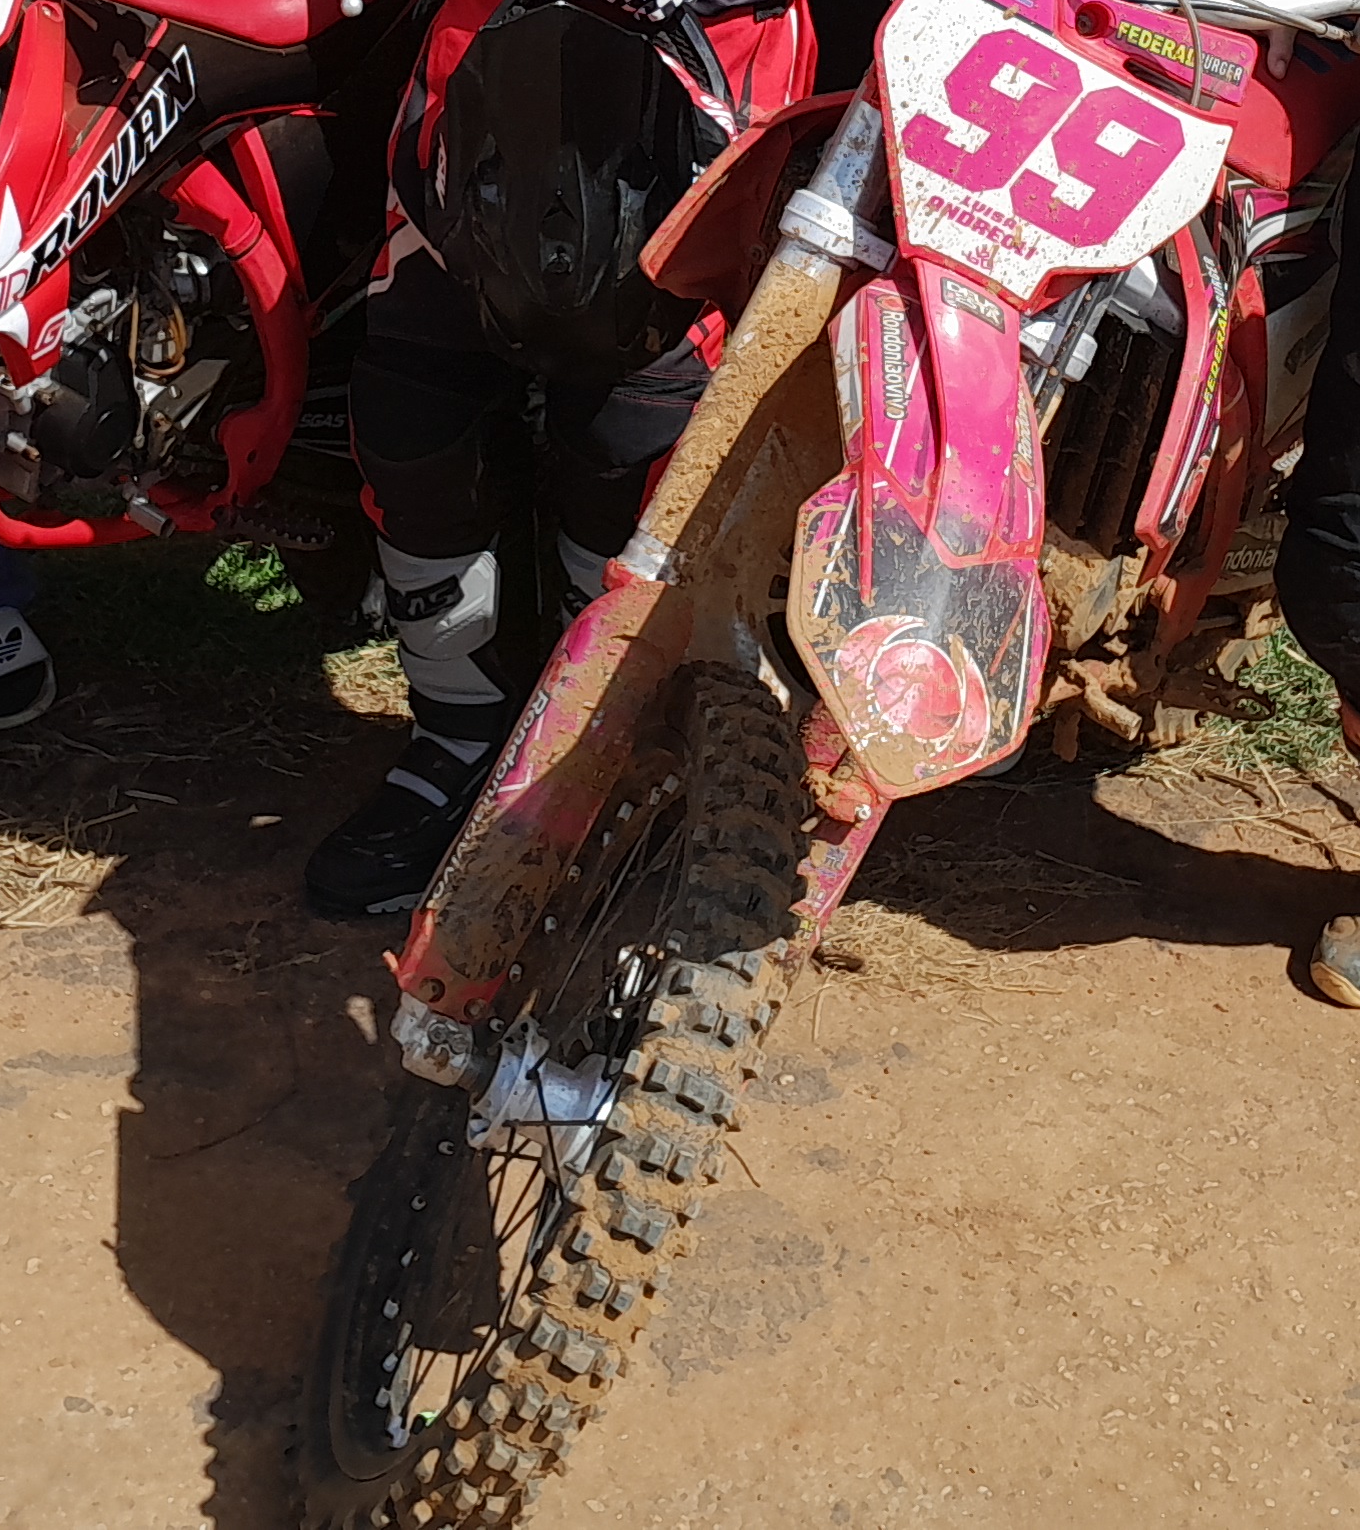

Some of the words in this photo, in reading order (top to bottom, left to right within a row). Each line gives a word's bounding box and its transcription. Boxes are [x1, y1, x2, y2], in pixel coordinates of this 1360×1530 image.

[1116, 20, 1195, 68] FEDERAL
[1202, 52, 1245, 82] URGER
[24, 44, 198, 294] ROVAN
[901, 28, 1186, 248] 99
[959, 195, 1018, 231] LUISA
[882, 310, 908, 420] Rondoniaovivo
[1203, 308, 1228, 405] FEDERAL
[300, 413, 347, 428] SGAS
